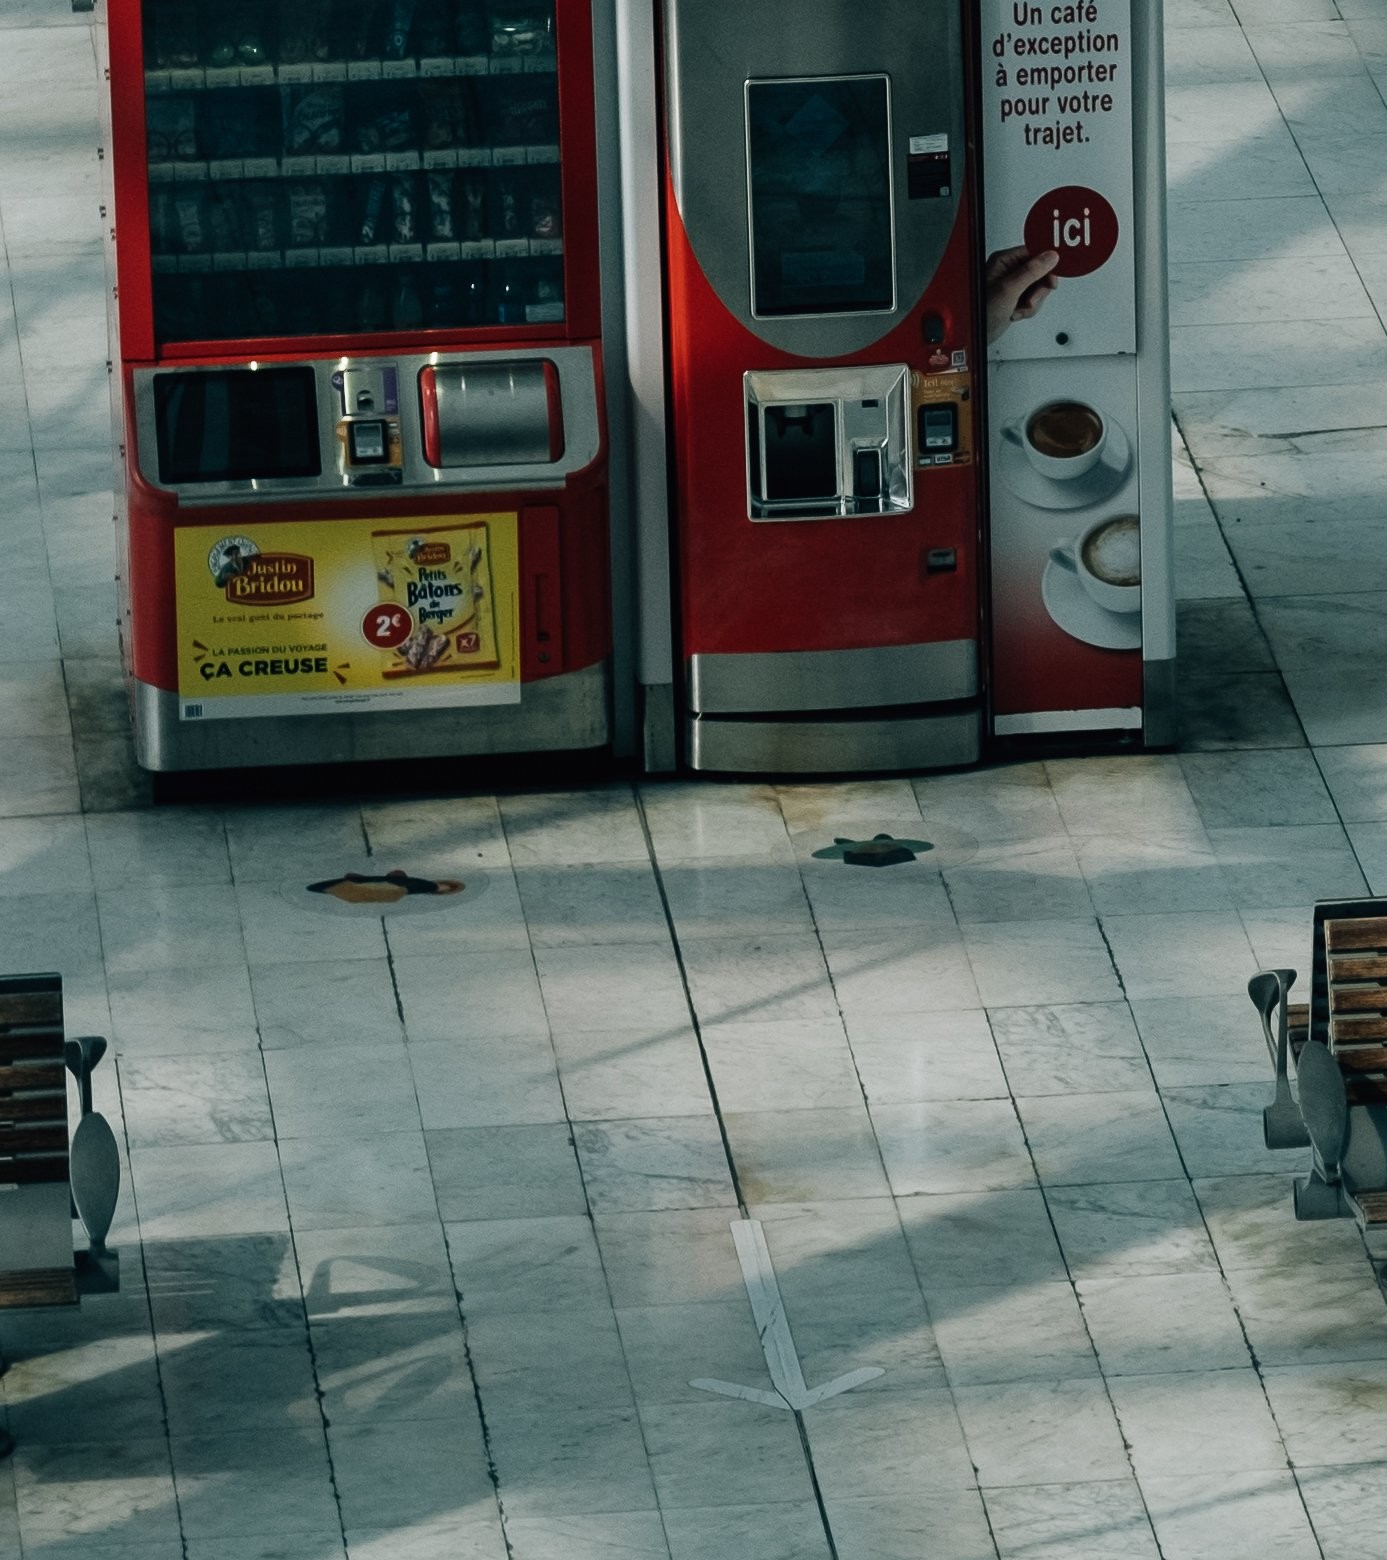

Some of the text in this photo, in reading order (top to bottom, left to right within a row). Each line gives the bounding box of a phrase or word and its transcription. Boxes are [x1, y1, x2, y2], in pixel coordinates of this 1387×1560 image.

[1012, 1, 1043, 25] Un
[995, 61, 1118, 93] à emporter
[1000, 92, 1114, 122] pour votre
[1024, 122, 1091, 149] trajet.
[1052, 207, 1092, 248] ici
[248, 560, 297, 575] Justin
[418, 567, 448, 583] Petits
[232, 575, 304, 597] Bridou
[375, 613, 401, 637] 2€
[418, 608, 455, 625] Berger
[212, 643, 328, 657] LA PASSION DU VOYAGE
[199, 657, 328, 681] ÇA CREUSE
